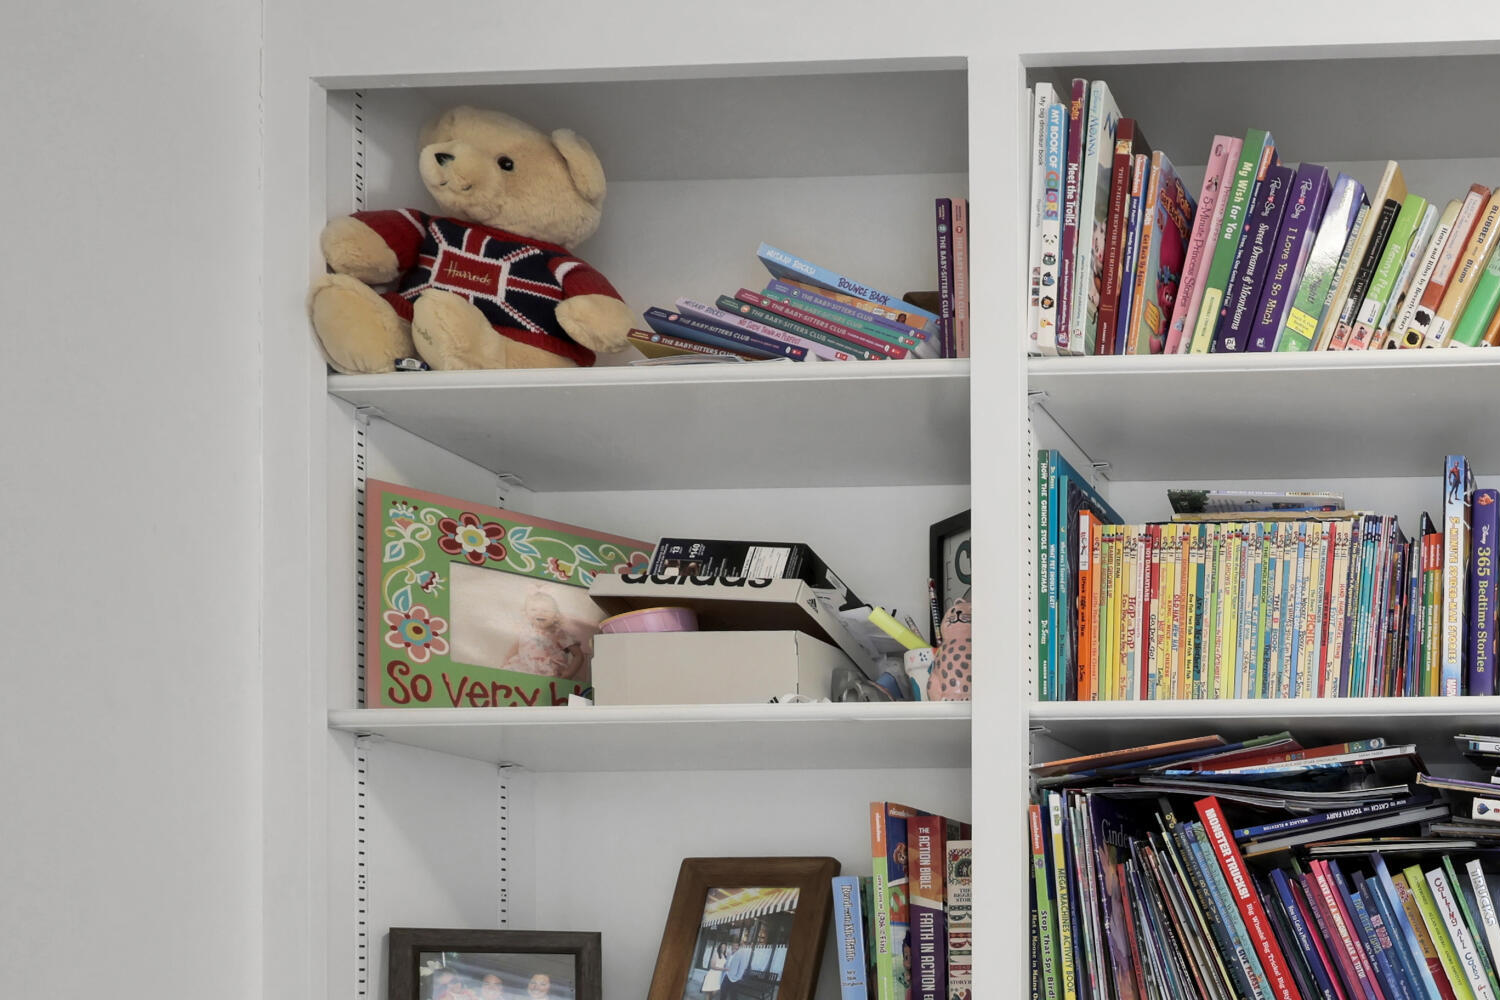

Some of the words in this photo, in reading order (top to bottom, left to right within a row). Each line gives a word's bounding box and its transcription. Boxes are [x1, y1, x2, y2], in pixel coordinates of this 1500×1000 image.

[1051, 109, 1060, 125] MY
[1070, 99, 1082, 121] Trolls
[1049, 126, 1059, 155] BOOK
[1049, 155, 1058, 168] OF
[1068, 163, 1079, 182] Meet
[1238, 161, 1253, 178] My
[1045, 170, 1060, 217] COLORS
[1067, 183, 1077, 199] the
[1233, 178, 1249, 203] Wish
[1065, 200, 1076, 226] Trolls!
[1229, 204, 1242, 221] for
[1476, 204, 1499, 245] BLUBBER
[939, 236, 947, 248] THE
[1223, 221, 1238, 241] You
[1280, 234, 1297, 261] Love
[443, 260, 492, 286] Harrods
[940, 251, 949, 298] BABY-SITTERS
[1274, 262, 1289, 282] You
[1457, 258, 1474, 285] Blume
[836, 275, 870, 298] BOUNCE
[868, 289, 890, 307] BACK
[1269, 282, 1283, 297] So
[1261, 298, 1278, 327] Much
[1480, 524, 1489, 544] Disney
[1477, 546, 1491, 576] 365
[1477, 580, 1489, 628] Bedtime
[1476, 631, 1488, 673] Stories
[387, 660, 432, 704] So
[442, 674, 541, 708] Very
[919, 835, 931, 865] ACTION
[1204, 807, 1233, 857] MONSTER
[1224, 856, 1250, 900] TRUCKS!
[919, 867, 931, 889] BIBLE
[1057, 867, 1067, 891] MEGA
[1470, 868, 1498, 927] TRUCKS
[1040, 910, 1049, 931] Stop
[1059, 893, 1070, 933] MACHINES
[920, 913, 934, 940] FAITH
[921, 943, 934, 953] IN
[1042, 934, 1051, 955] That
[1063, 935, 1073, 968] ACTIVITY
[921, 955, 935, 991] ACTION
[1045, 957, 1053, 973] Spy
[1047, 976, 1056, 999] Bird!
[1066, 970, 1075, 992] BOOK
